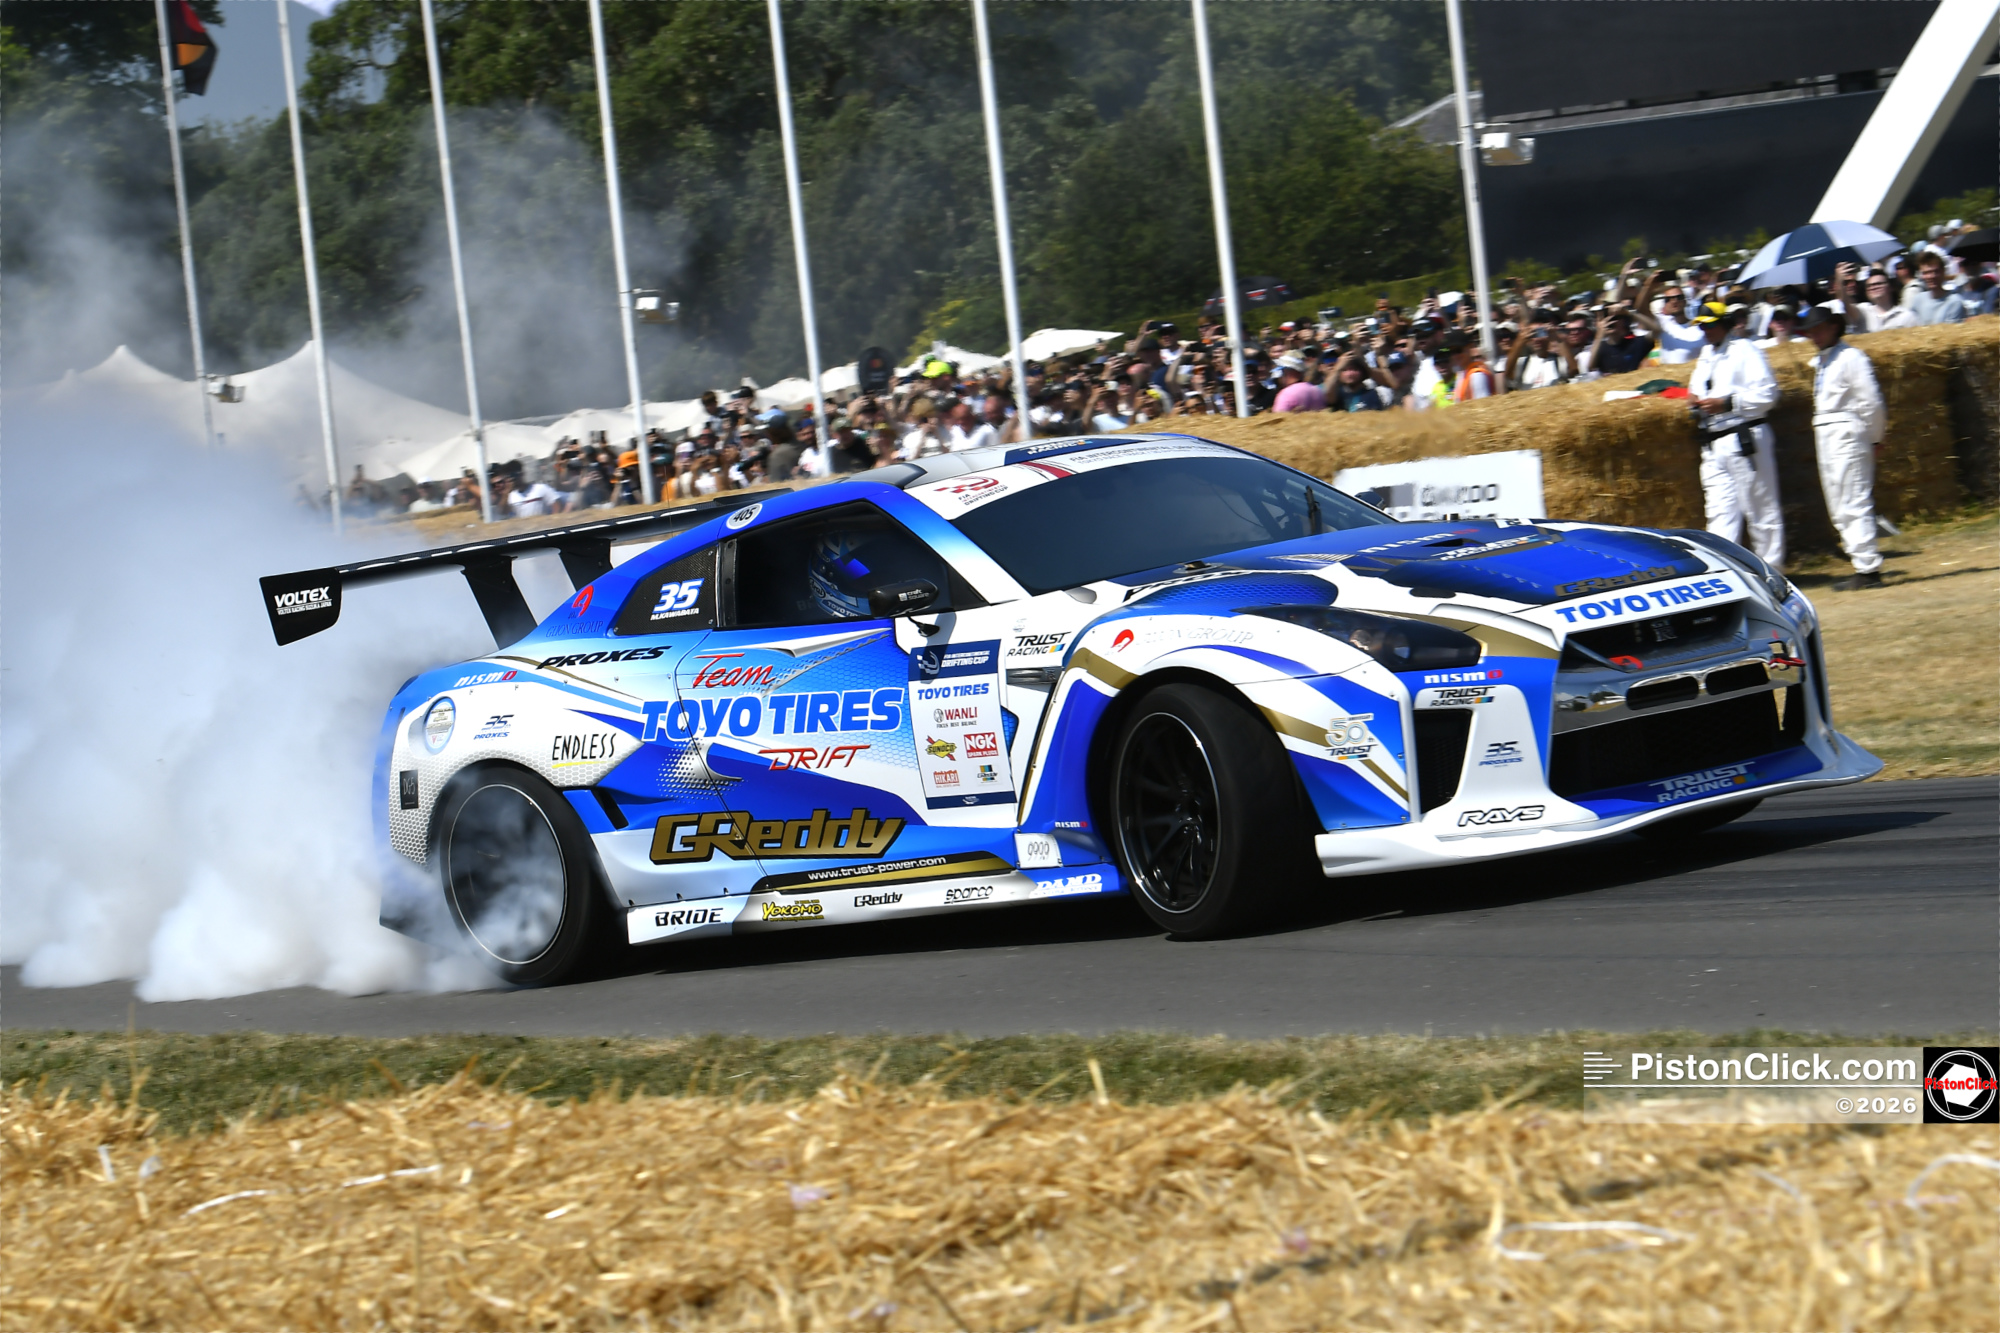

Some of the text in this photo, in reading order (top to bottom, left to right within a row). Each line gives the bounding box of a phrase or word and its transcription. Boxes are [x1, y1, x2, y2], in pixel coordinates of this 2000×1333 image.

[733, 506, 757, 522] 405
[274, 586, 330, 608] VOLTEX
[652, 578, 705, 614] 35
[1555, 578, 1733, 623] TOYO TIRES
[571, 620, 604, 635] GROUP
[1015, 631, 1072, 647] TRUST
[537, 646, 673, 670] PROXES
[973, 656, 990, 665] CUP
[1006, 646, 1050, 657] RACING
[693, 653, 776, 689] Team
[917, 683, 990, 701] TOYO TIRES
[1434, 686, 1497, 699] TRUST
[1430, 697, 1475, 707] RACING
[641, 687, 904, 741] TOYO TIRES
[945, 707, 978, 721] WANLI
[473, 732, 510, 740] PROXES
[1325, 717, 1369, 746] 50
[552, 733, 617, 760] ENDLESS
[928, 744, 956, 753] SUNOCO
[965, 733, 996, 751] NGK
[1325, 744, 1379, 756] TRUST
[758, 744, 871, 771] DRIFT
[935, 772, 960, 785] HIKARI
[1648, 761, 1756, 791] TRUST
[1656, 778, 1734, 803] RACING
[1457, 804, 1546, 827] RAYS
[650, 808, 907, 865] GReddy
[808, 856, 947, 881] www.trust-power.com
[1037, 874, 1102, 890] DAMD
[854, 891, 904, 908] GReddy
[945, 885, 994, 902] sparco
[655, 907, 725, 927] BRIDE
[762, 901, 823, 921] YOKOMO
